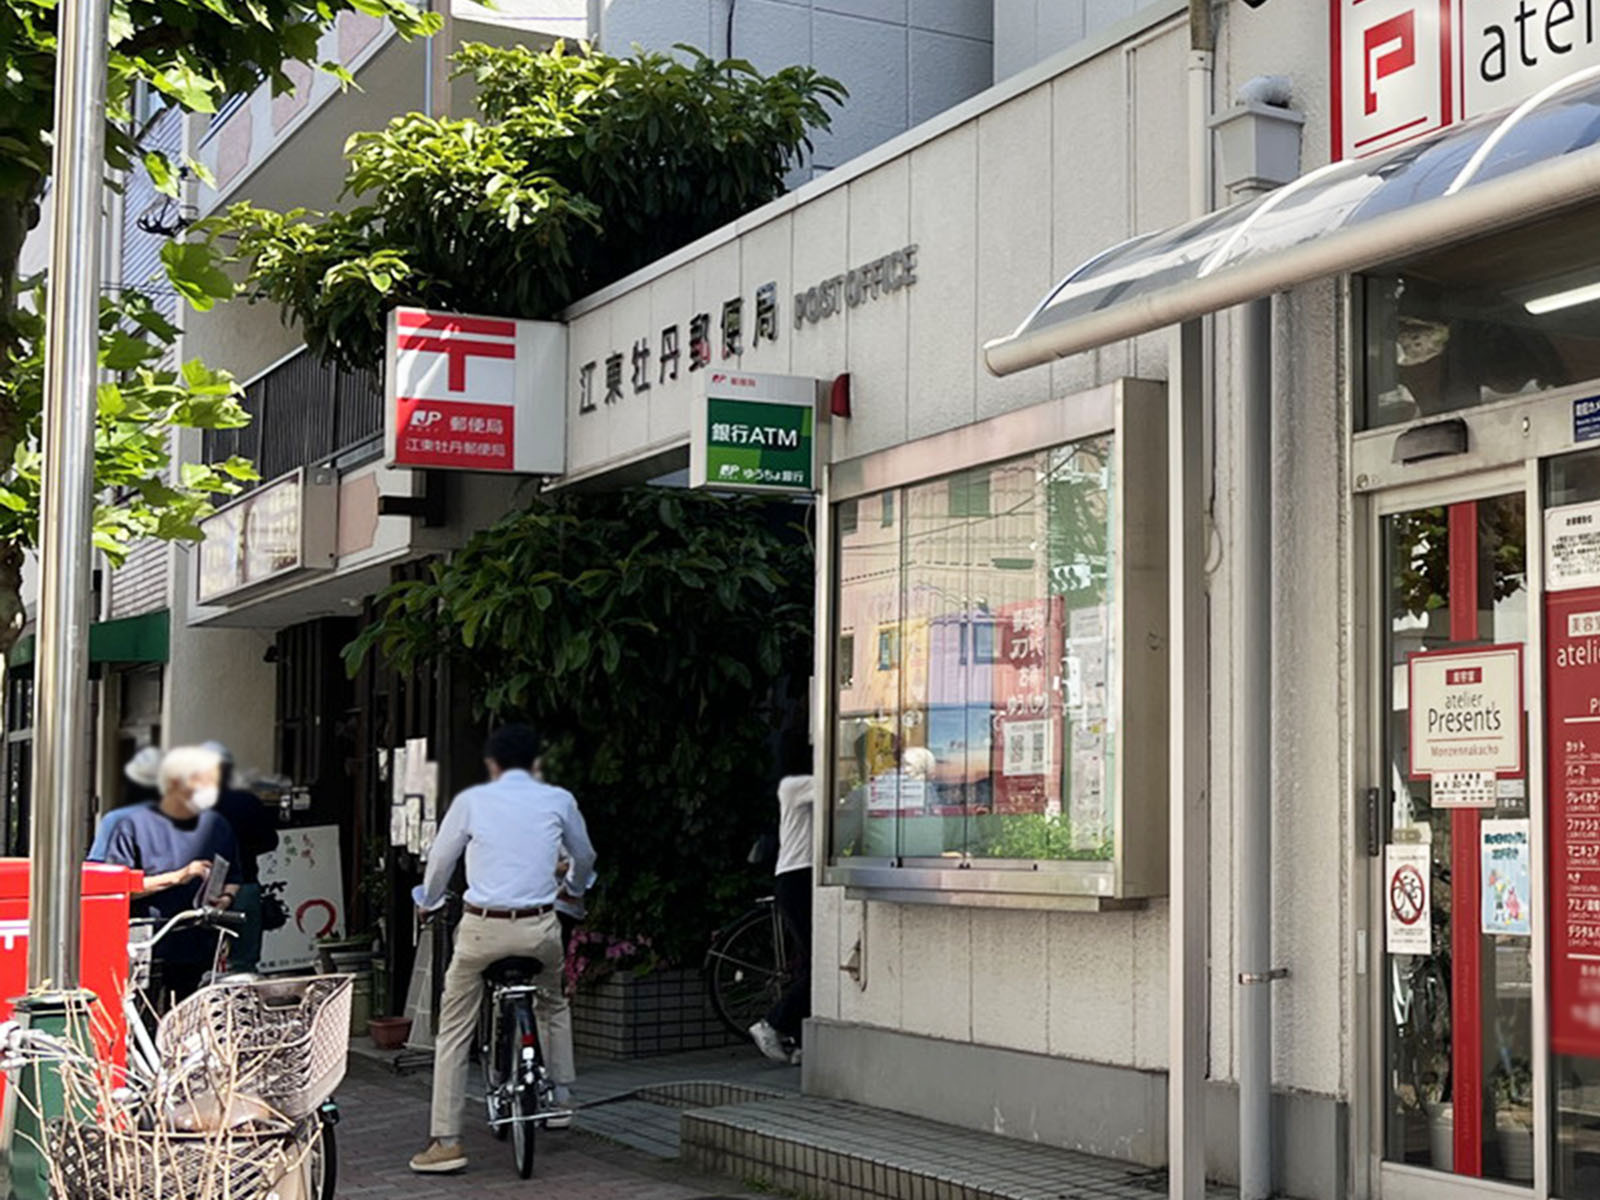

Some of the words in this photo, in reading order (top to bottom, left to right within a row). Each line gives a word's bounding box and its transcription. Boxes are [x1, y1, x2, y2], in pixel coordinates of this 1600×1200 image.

[794, 274, 845, 330] POST
[845, 243, 919, 308] OFFICE
[579, 281, 778, 415] 江東牡丹郵便局
[451, 416, 504, 435] 郵便局
[743, 468, 805, 483] ゆうちょ銀行
[1557, 638, 1600, 668] ateli
[1444, 690, 1484, 710] atelier
[1566, 791, 1600, 804] グレイカラ
